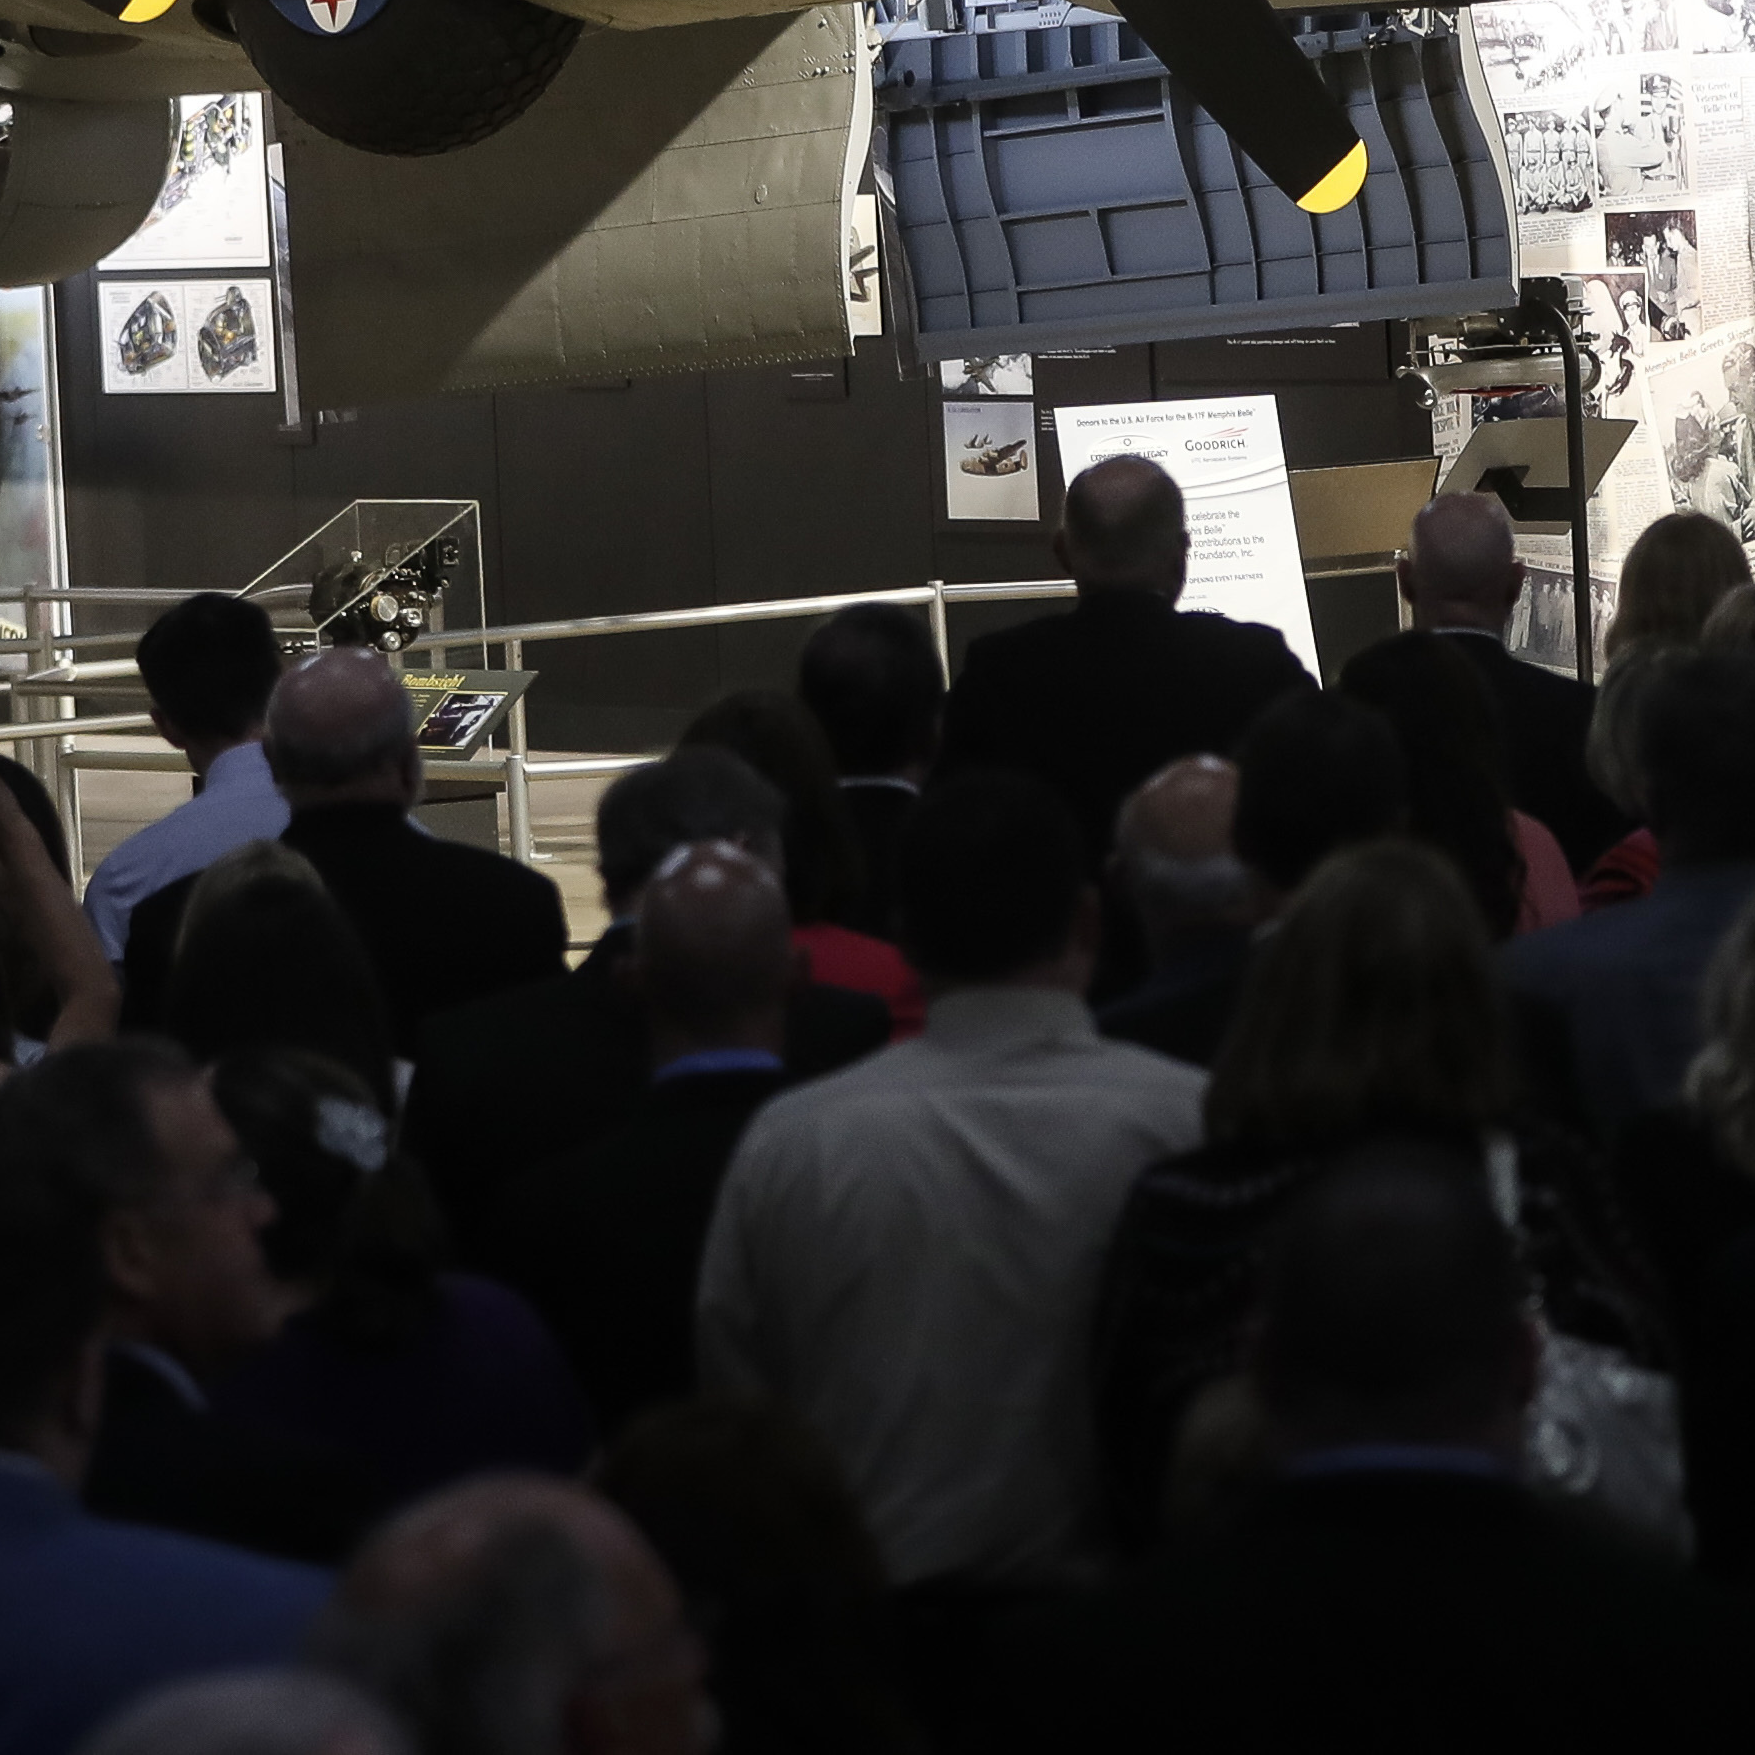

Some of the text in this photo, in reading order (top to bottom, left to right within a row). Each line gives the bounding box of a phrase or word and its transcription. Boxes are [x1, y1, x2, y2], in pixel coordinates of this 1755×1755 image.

[1679, 348, 1698, 362] Belle
[1700, 338, 1724, 353] Greets
[1146, 414, 1164, 423] Force
[1208, 410, 1236, 420] Memphis
[1192, 511, 1226, 521] celebrate
[1228, 510, 1240, 519] the
[1194, 538, 1242, 548] contributions
[1252, 535, 1265, 544] the
[401, 674, 467, 688] Bombsight
